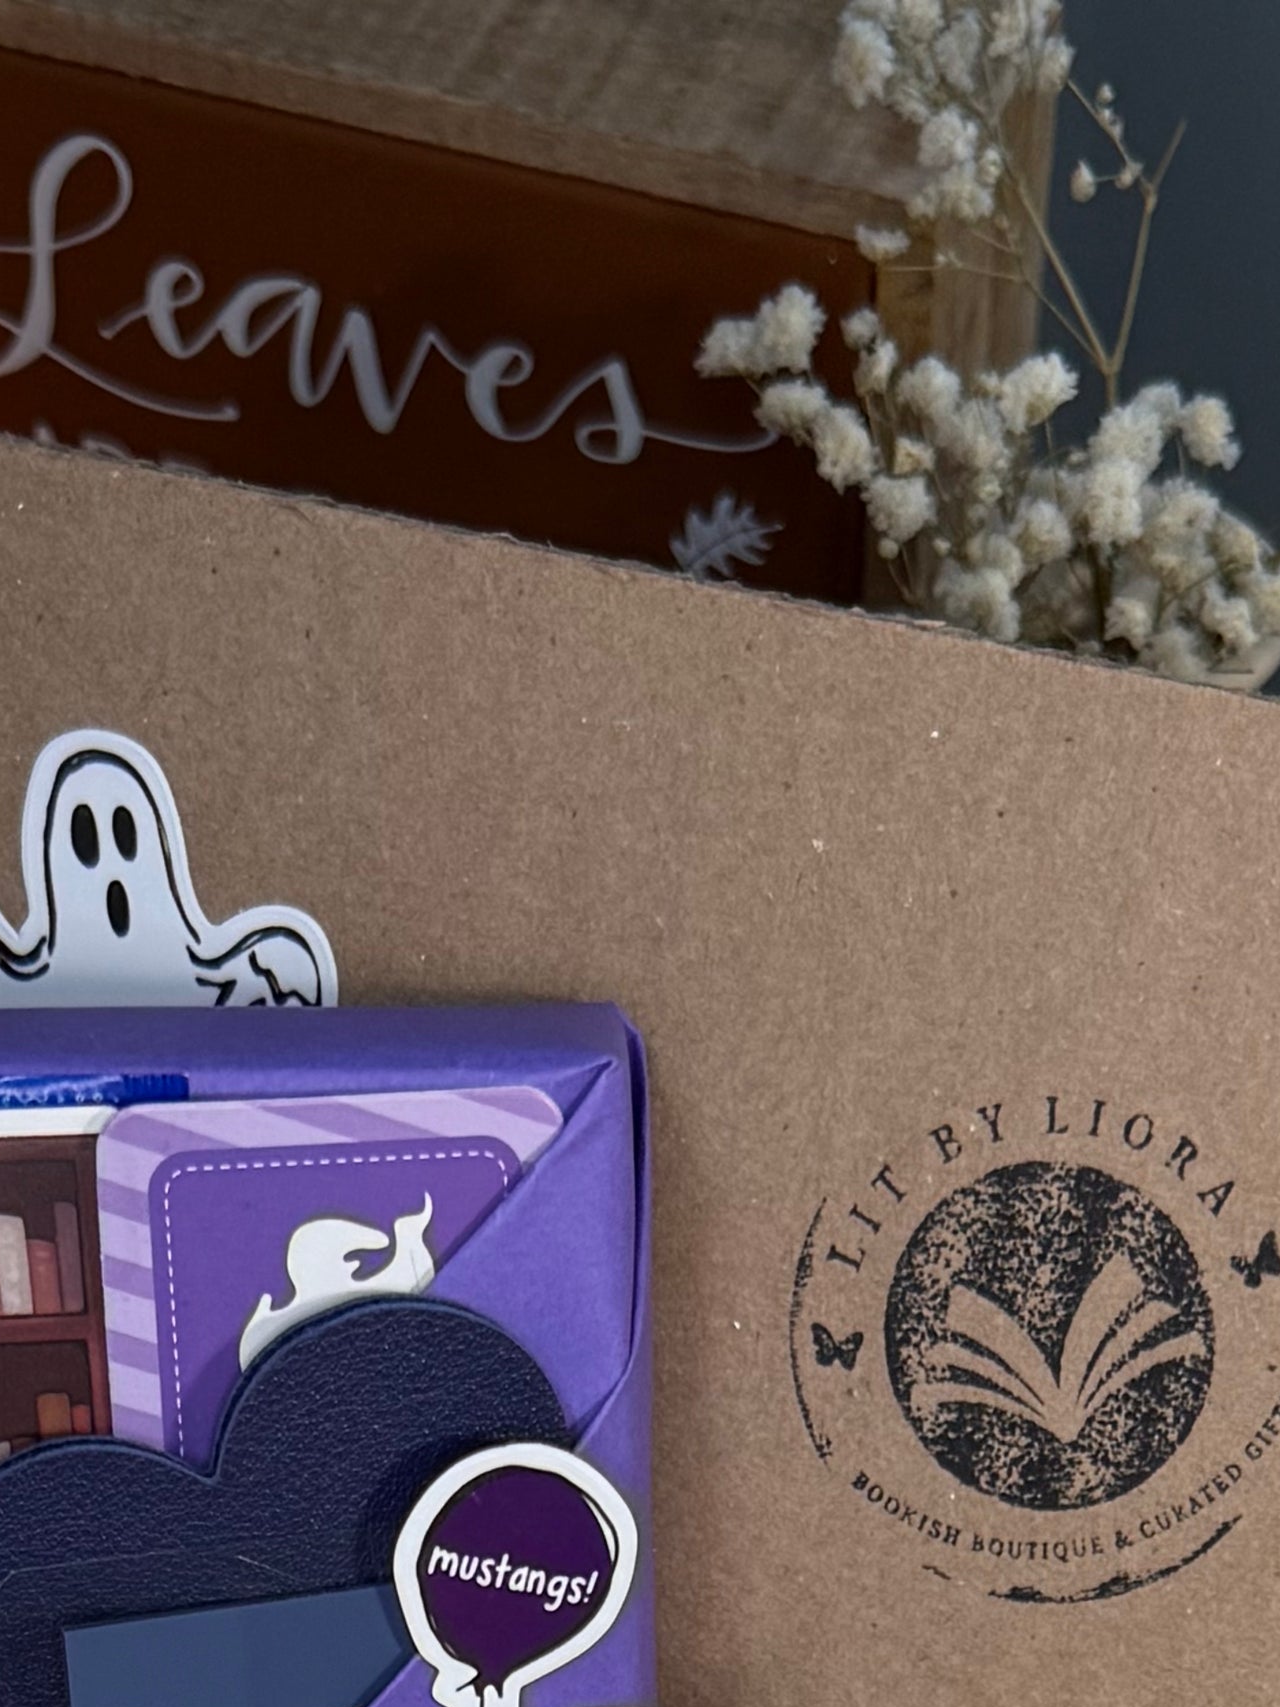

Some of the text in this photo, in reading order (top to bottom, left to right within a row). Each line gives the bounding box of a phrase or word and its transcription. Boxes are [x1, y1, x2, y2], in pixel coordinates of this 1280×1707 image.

[826, 1095, 1237, 1273] LIT BY LIORA
[851, 1470, 961, 1547] BOOKISH
[971, 1531, 1105, 1564] BOUTIQUE
[1114, 1529, 1135, 1552] &
[428, 1541, 599, 1612] mustangs!
